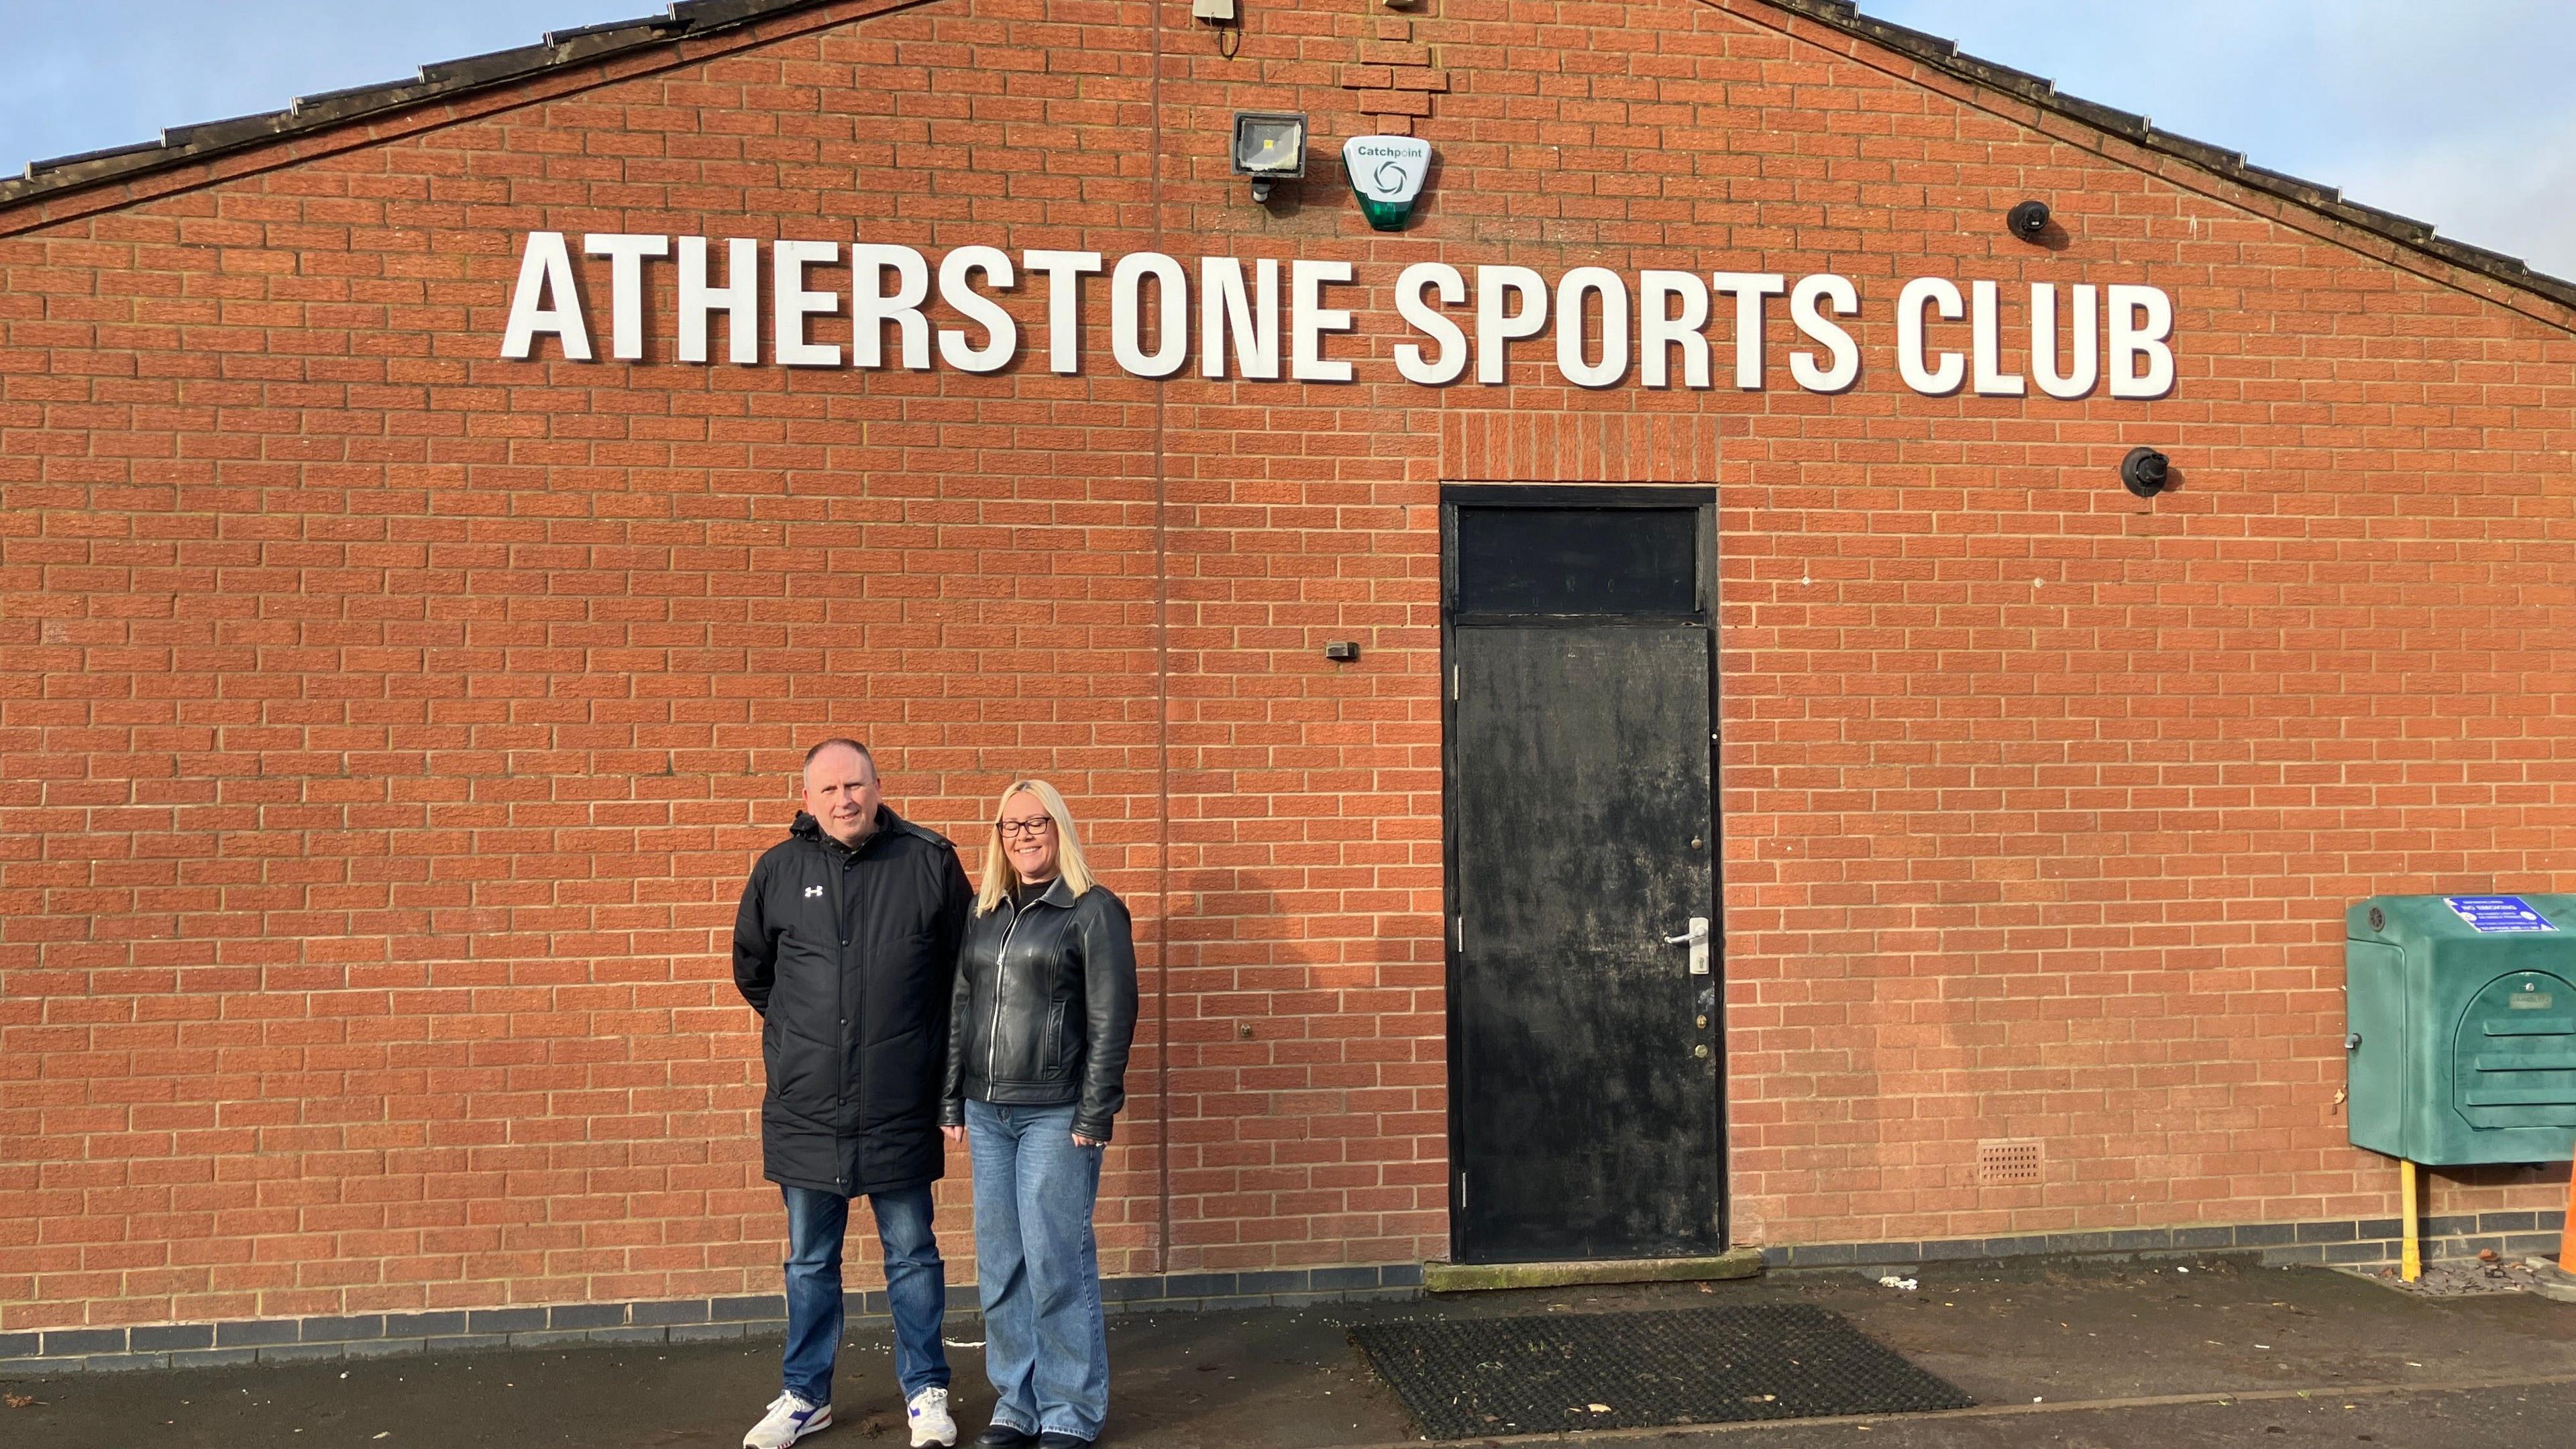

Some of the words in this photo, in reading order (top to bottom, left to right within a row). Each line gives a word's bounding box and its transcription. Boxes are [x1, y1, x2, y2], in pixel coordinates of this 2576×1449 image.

[1358, 146, 1421, 158] Catchpoint
[500, 231, 1352, 382] ATHERSTONE
[1394, 262, 1859, 392] SPORTS
[1897, 276, 2174, 398] CLUB
